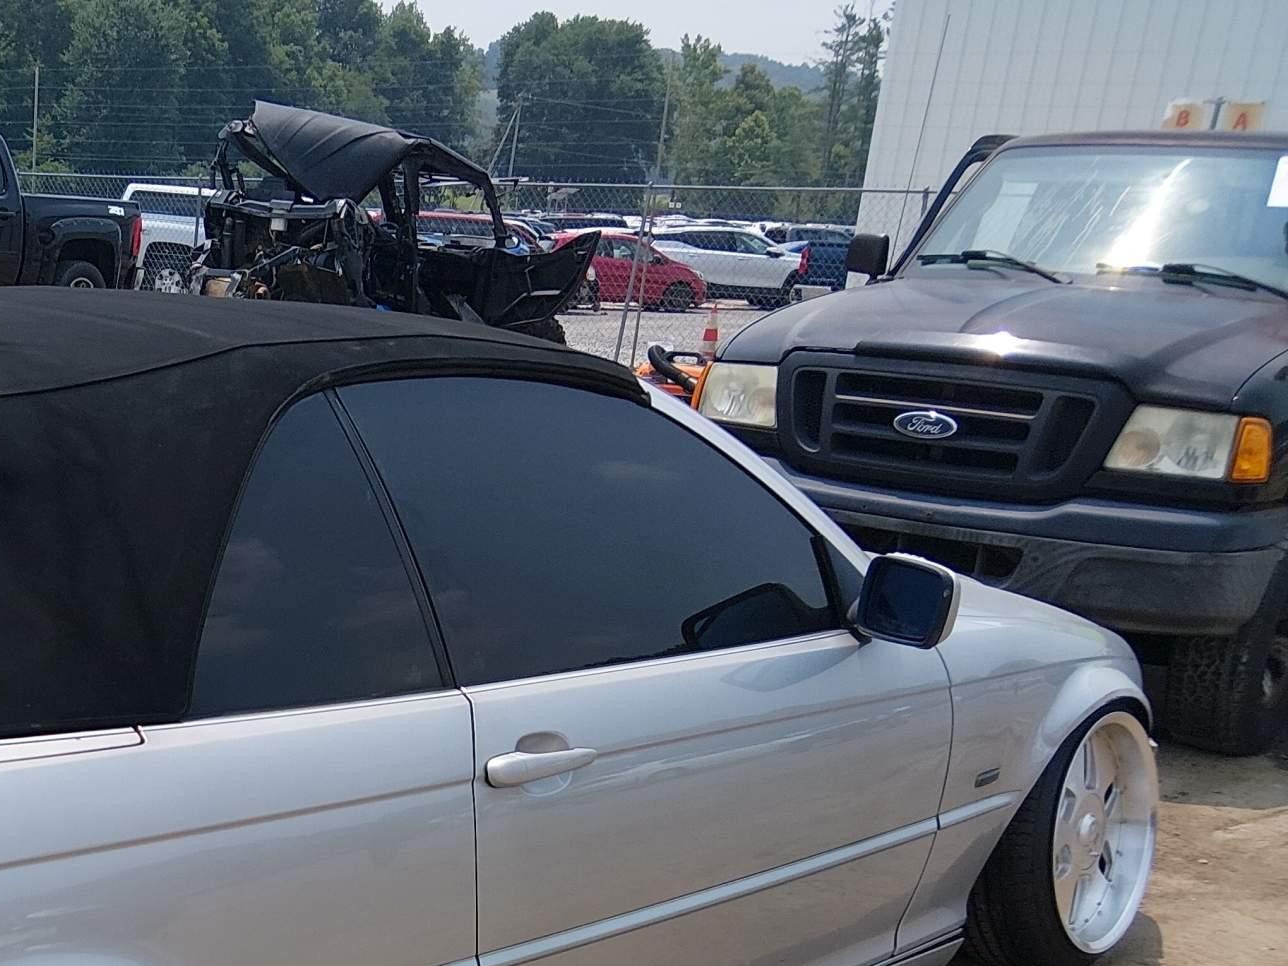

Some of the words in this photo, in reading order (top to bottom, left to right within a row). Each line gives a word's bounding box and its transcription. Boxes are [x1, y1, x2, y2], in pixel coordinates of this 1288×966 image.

[1175, 109, 1191, 128] B
[1232, 111, 1248, 131] A
[907, 415, 943, 434] Ford
